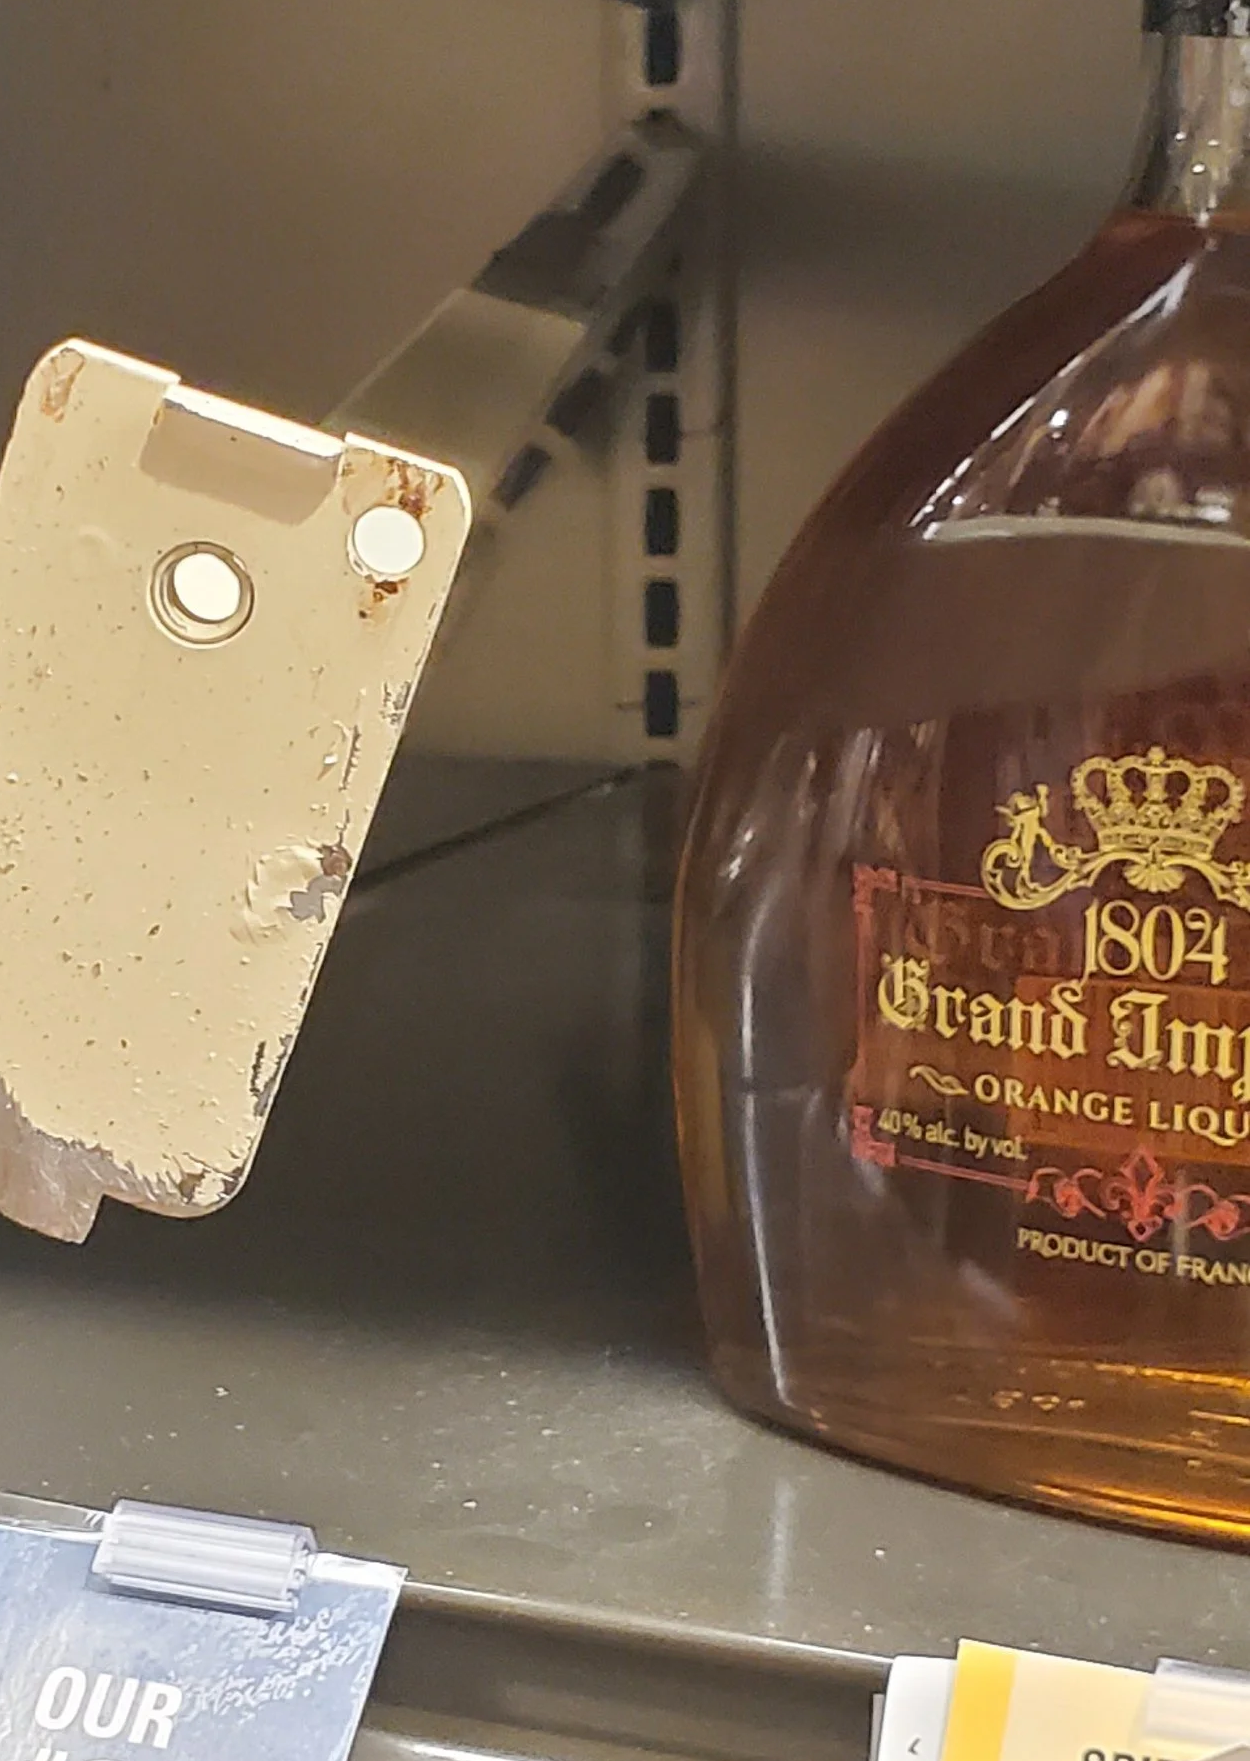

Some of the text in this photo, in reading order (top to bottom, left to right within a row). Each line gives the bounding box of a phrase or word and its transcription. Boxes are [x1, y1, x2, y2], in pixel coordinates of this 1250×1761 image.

[1084, 899, 1230, 986] 1804
[877, 953, 1087, 1059] Grand
[878, 1107, 922, 1138] 40%
[925, 1120, 960, 1147] alc.
[964, 1129, 989, 1157] by
[974, 1072, 1134, 1127] ORANGE
[1017, 1227, 1129, 1267] PRODUCT
[1134, 1251, 1173, 1274] OF
[34, 1665, 184, 1750] OUR
